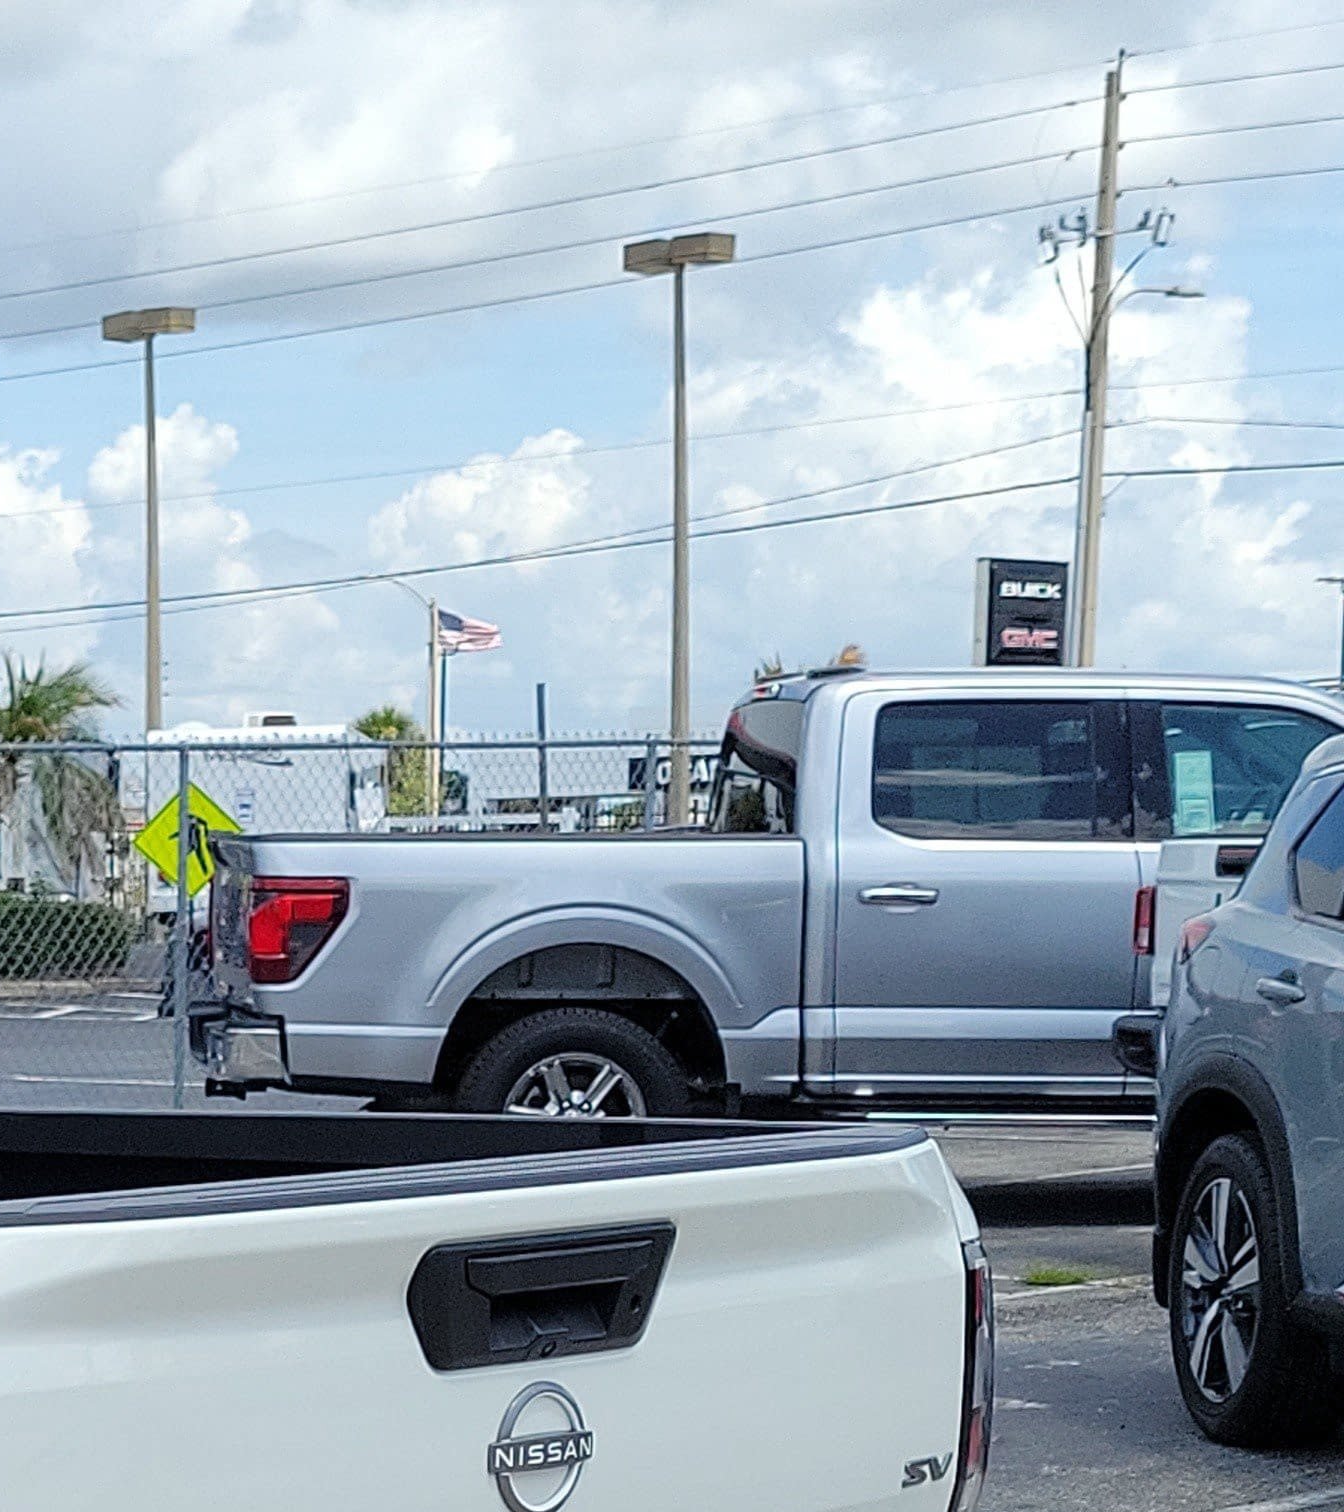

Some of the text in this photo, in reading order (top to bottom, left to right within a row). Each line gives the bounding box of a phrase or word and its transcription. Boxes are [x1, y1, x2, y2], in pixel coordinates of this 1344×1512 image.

[1000, 581, 1062, 599] BUICK
[1000, 627, 1058, 649] GMC
[494, 1436, 592, 1469] NISSAN
[901, 1451, 953, 1489] SV
